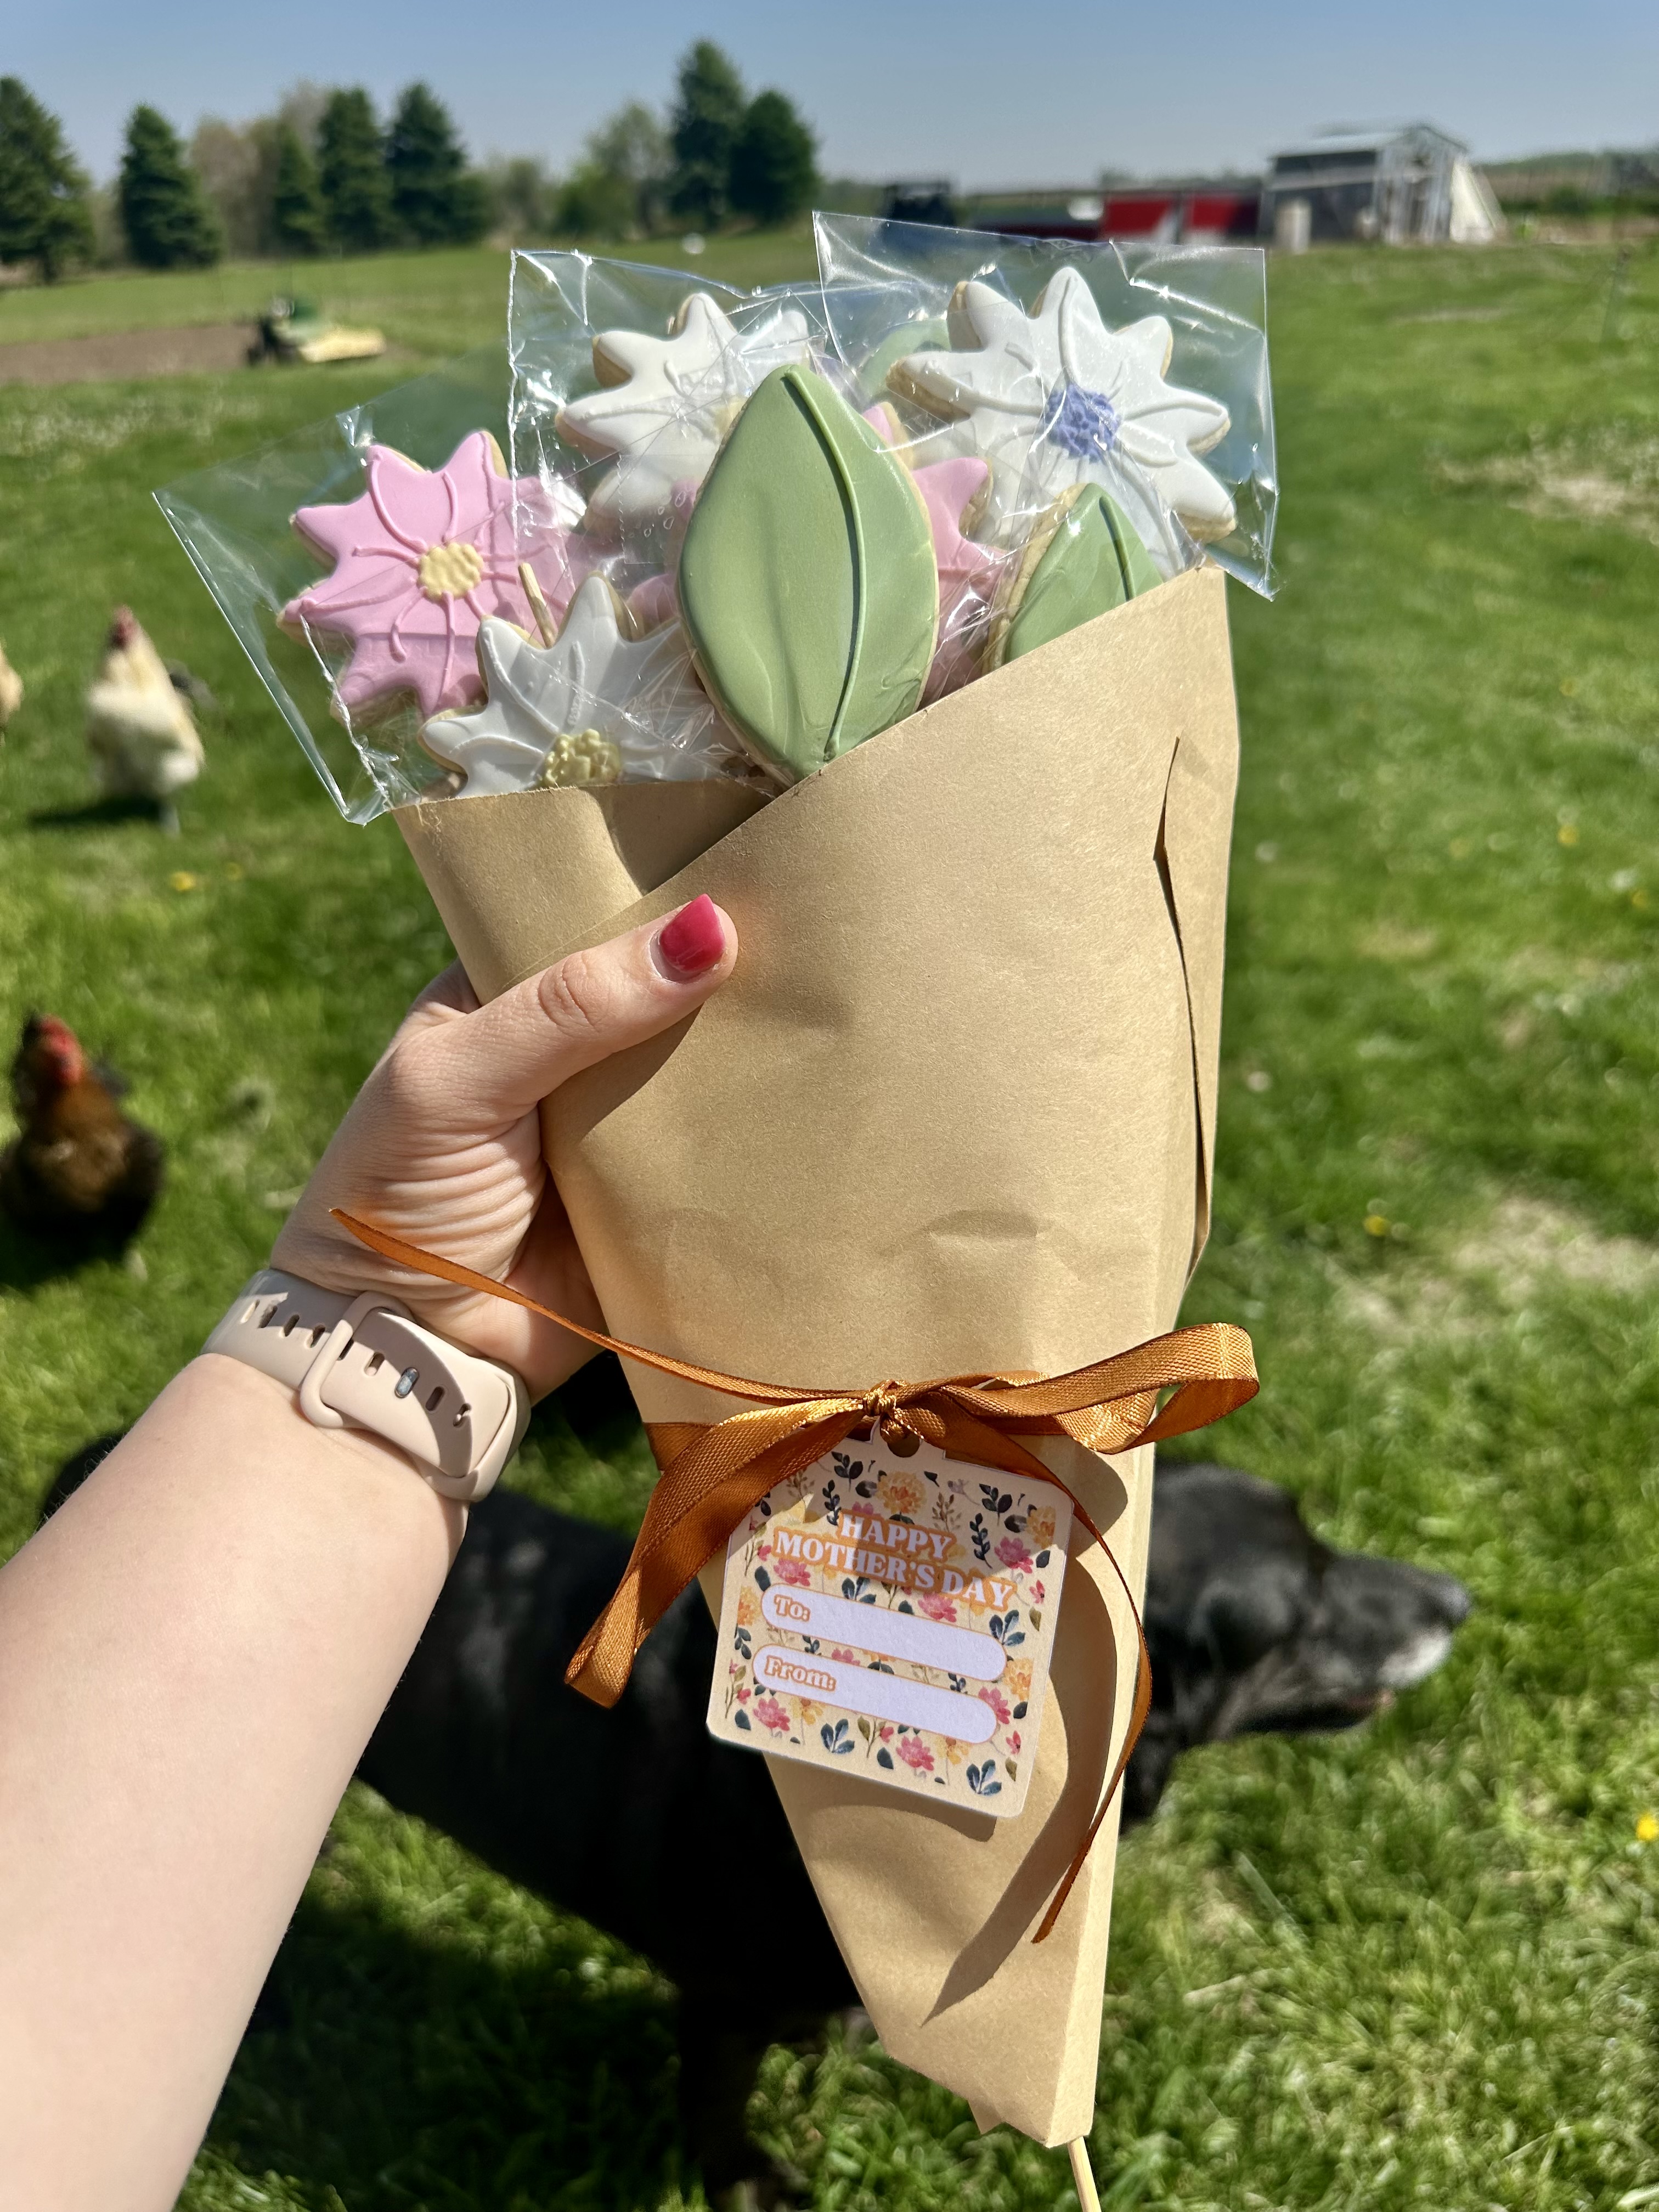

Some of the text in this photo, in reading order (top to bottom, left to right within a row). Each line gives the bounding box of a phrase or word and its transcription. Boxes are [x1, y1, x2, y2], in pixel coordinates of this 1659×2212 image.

[840, 1511, 955, 1560] HAPPY
[774, 1529, 1015, 1610] MOTHER'S DAY
[774, 1595, 810, 1622] To:
[764, 1655, 836, 1692] From:
